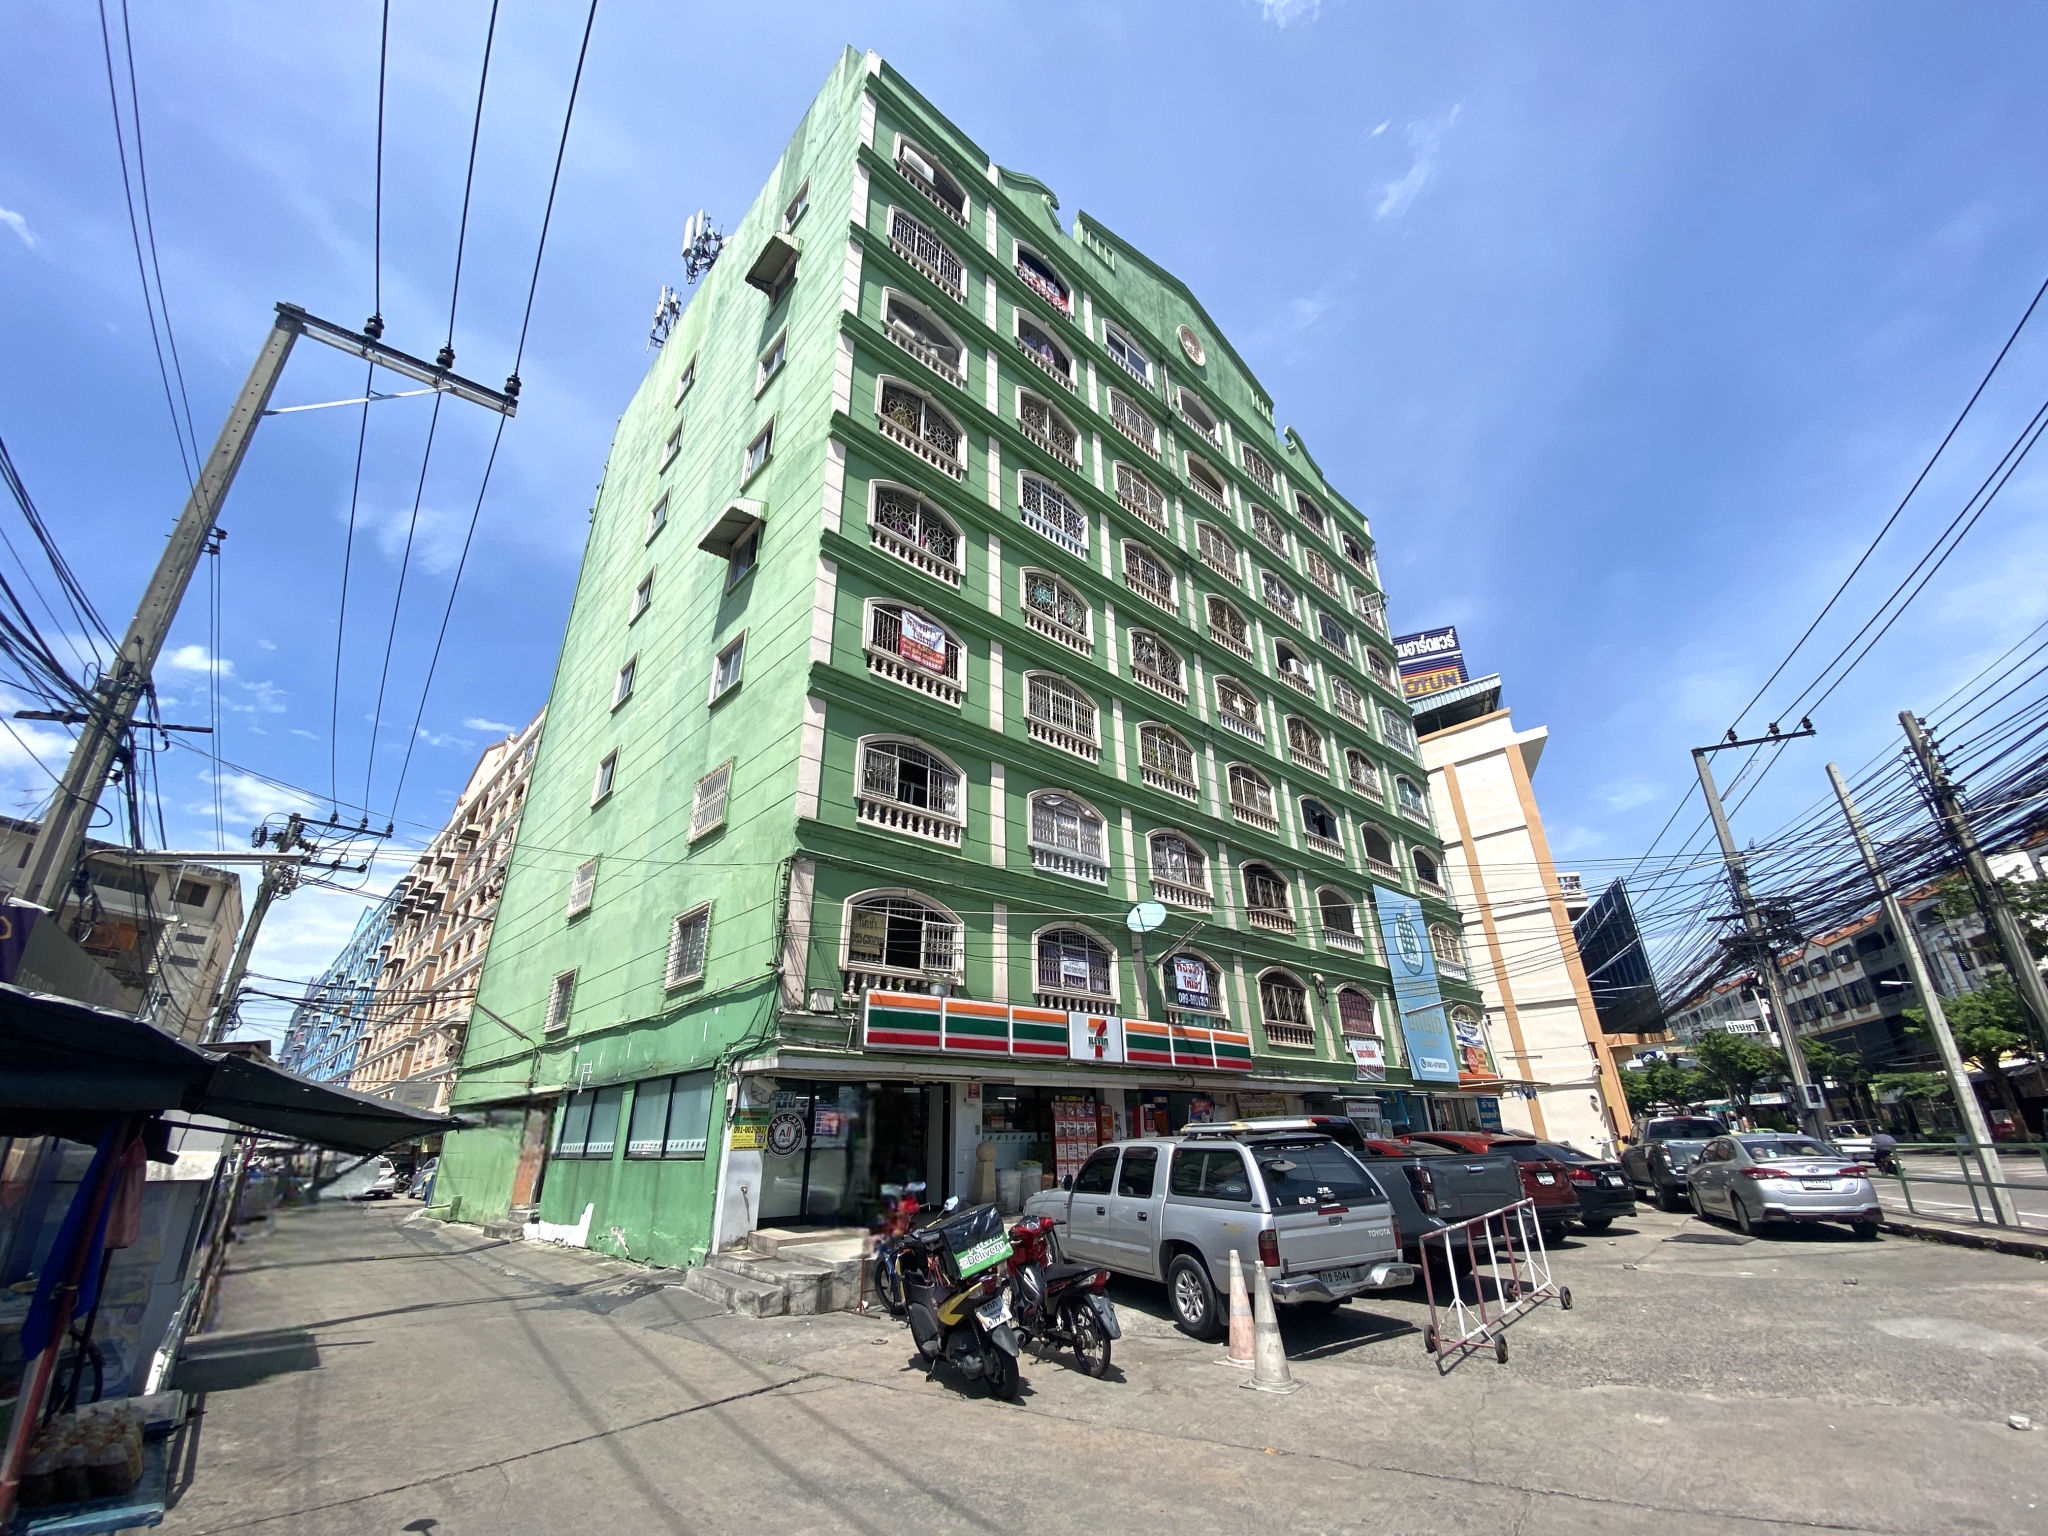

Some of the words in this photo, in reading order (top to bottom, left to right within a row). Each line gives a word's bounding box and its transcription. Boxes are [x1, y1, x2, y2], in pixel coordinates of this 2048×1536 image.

[1087, 1017, 1107, 1058] 7
[778, 1126, 792, 1138] All
[1367, 1228, 1391, 1239] TOYOTA
[967, 1242, 1005, 1265] Delivery
[1333, 1269, 1350, 1282] 5044
